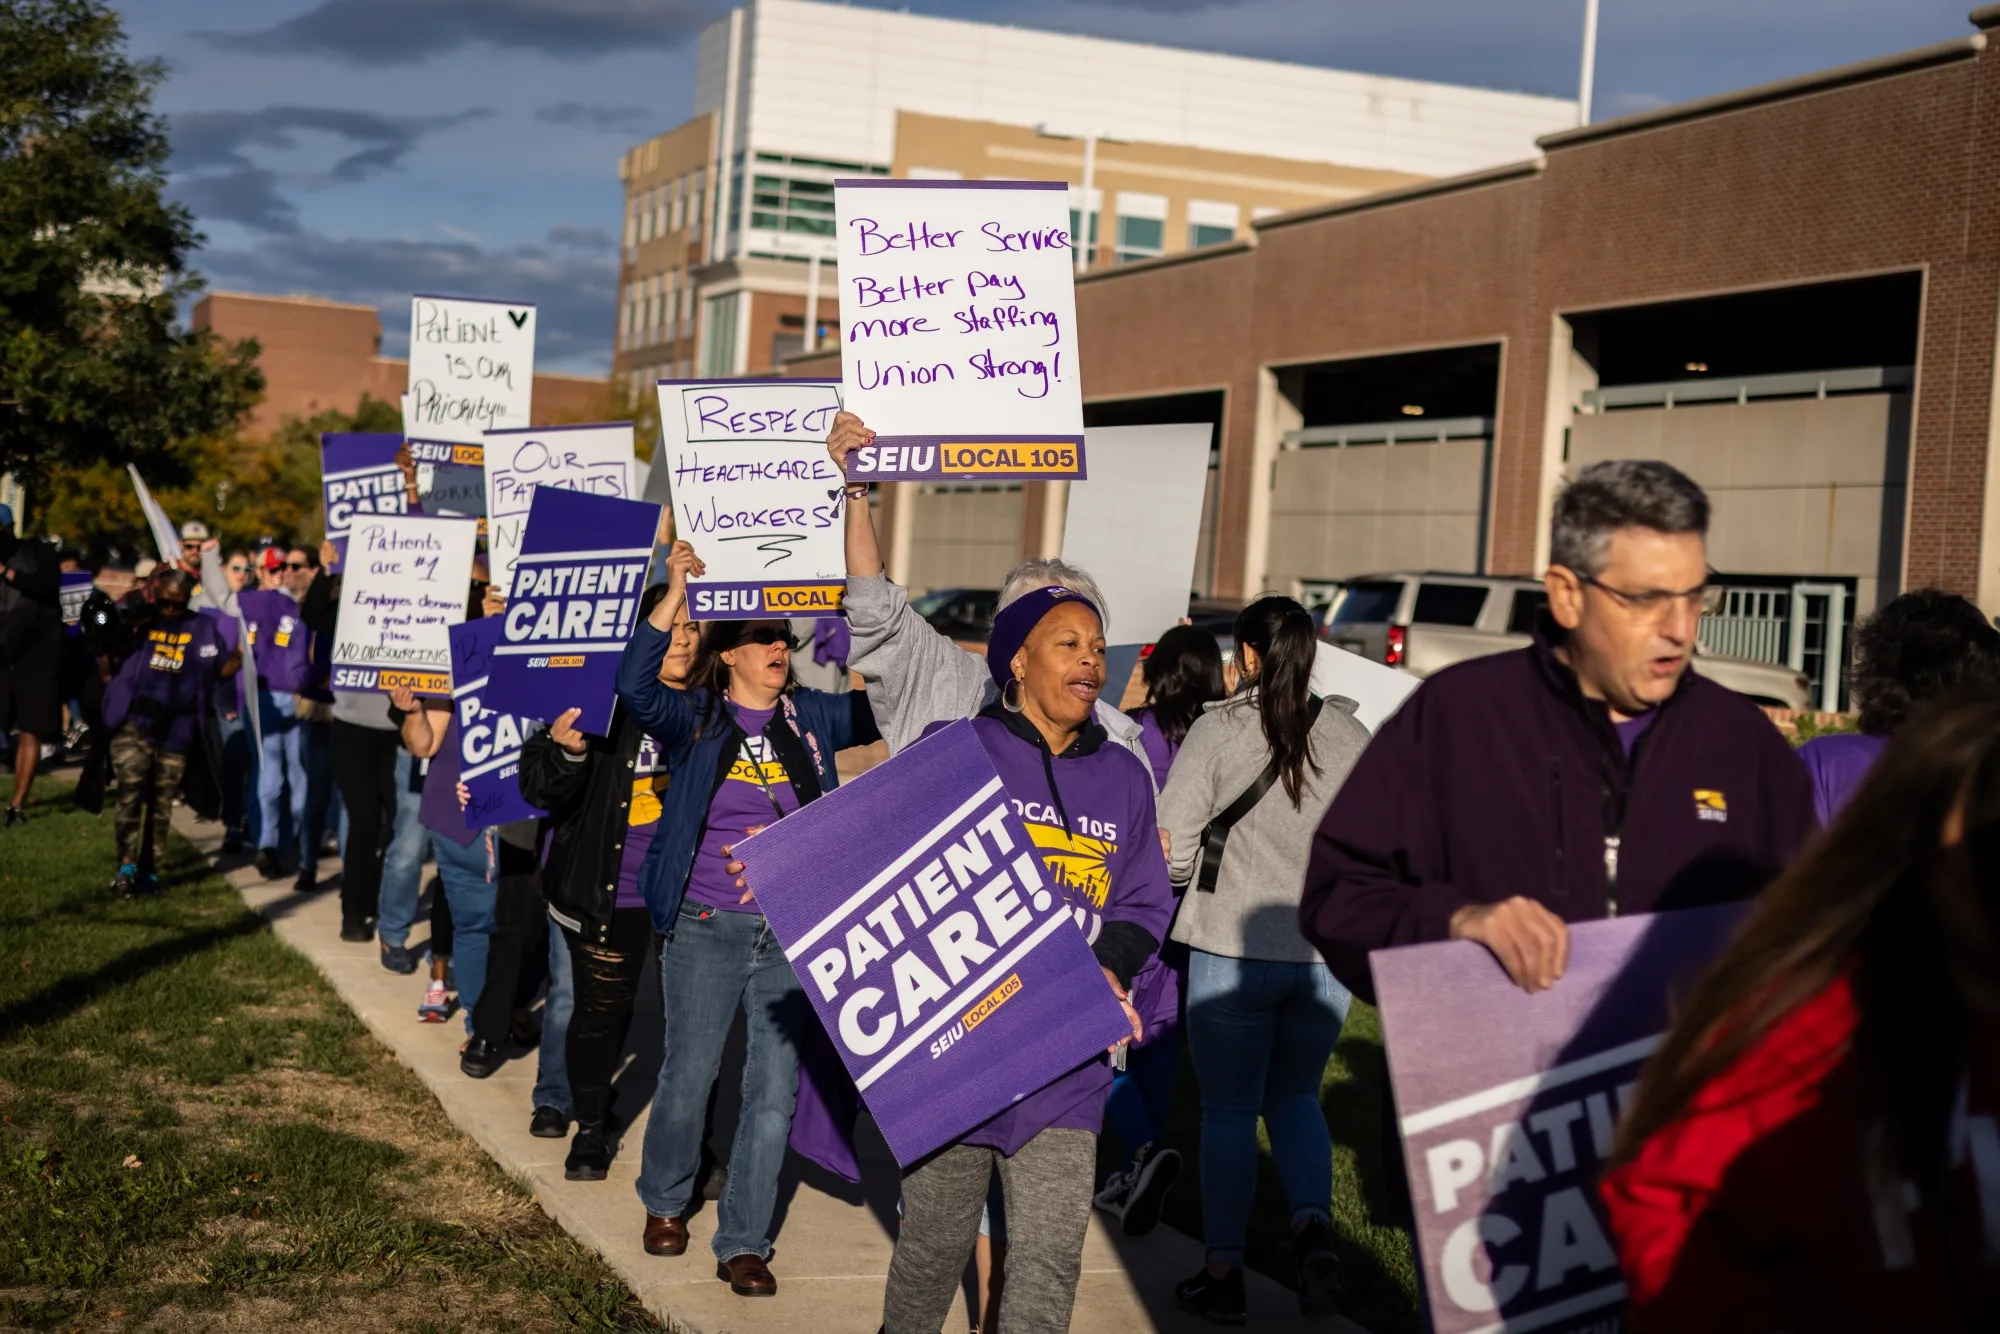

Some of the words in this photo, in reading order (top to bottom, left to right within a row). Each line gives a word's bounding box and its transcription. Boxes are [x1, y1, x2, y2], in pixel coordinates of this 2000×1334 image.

[850, 217, 964, 256] Better
[980, 221, 1073, 252] Service
[852, 276, 954, 308] Better
[857, 359, 954, 391] Union
[968, 348, 1062, 399] Strong!
[694, 395, 839, 434] RESPECT
[411, 442, 452, 462] SEIU
[455, 449, 484, 462] LOC
[512, 439, 586, 474] OUR
[675, 451, 838, 488] HEALTHCARE
[856, 446, 936, 473] SEIU
[943, 448, 1026, 468] LOCAL
[1030, 447, 1075, 468] 105
[327, 470, 405, 504] PATIE
[328, 494, 408, 529] CAR
[683, 495, 833, 534] WORKERS
[360, 523, 442, 552] Patients
[370, 560, 403, 575] are
[513, 563, 645, 599] PATIENT
[695, 589, 760, 612] SEIU
[766, 590, 834, 608] LOCAL
[504, 598, 636, 642] CARE!
[333, 668, 378, 689] SEIU
[381, 675, 425, 689] LOCAL
[527, 657, 549, 668] SEIU
[549, 657, 571, 666] LOCAL
[571, 657, 584, 665] 105
[1077, 815, 1117, 841] 105
[807, 802, 1011, 1003] PATIENT
[838, 850, 1053, 1057] CARE!
[930, 1020, 964, 1060] SEIU
[964, 996, 1001, 1029] LOCAL
[999, 977, 1020, 1000] 105
[1424, 1080, 1640, 1214] PATI
